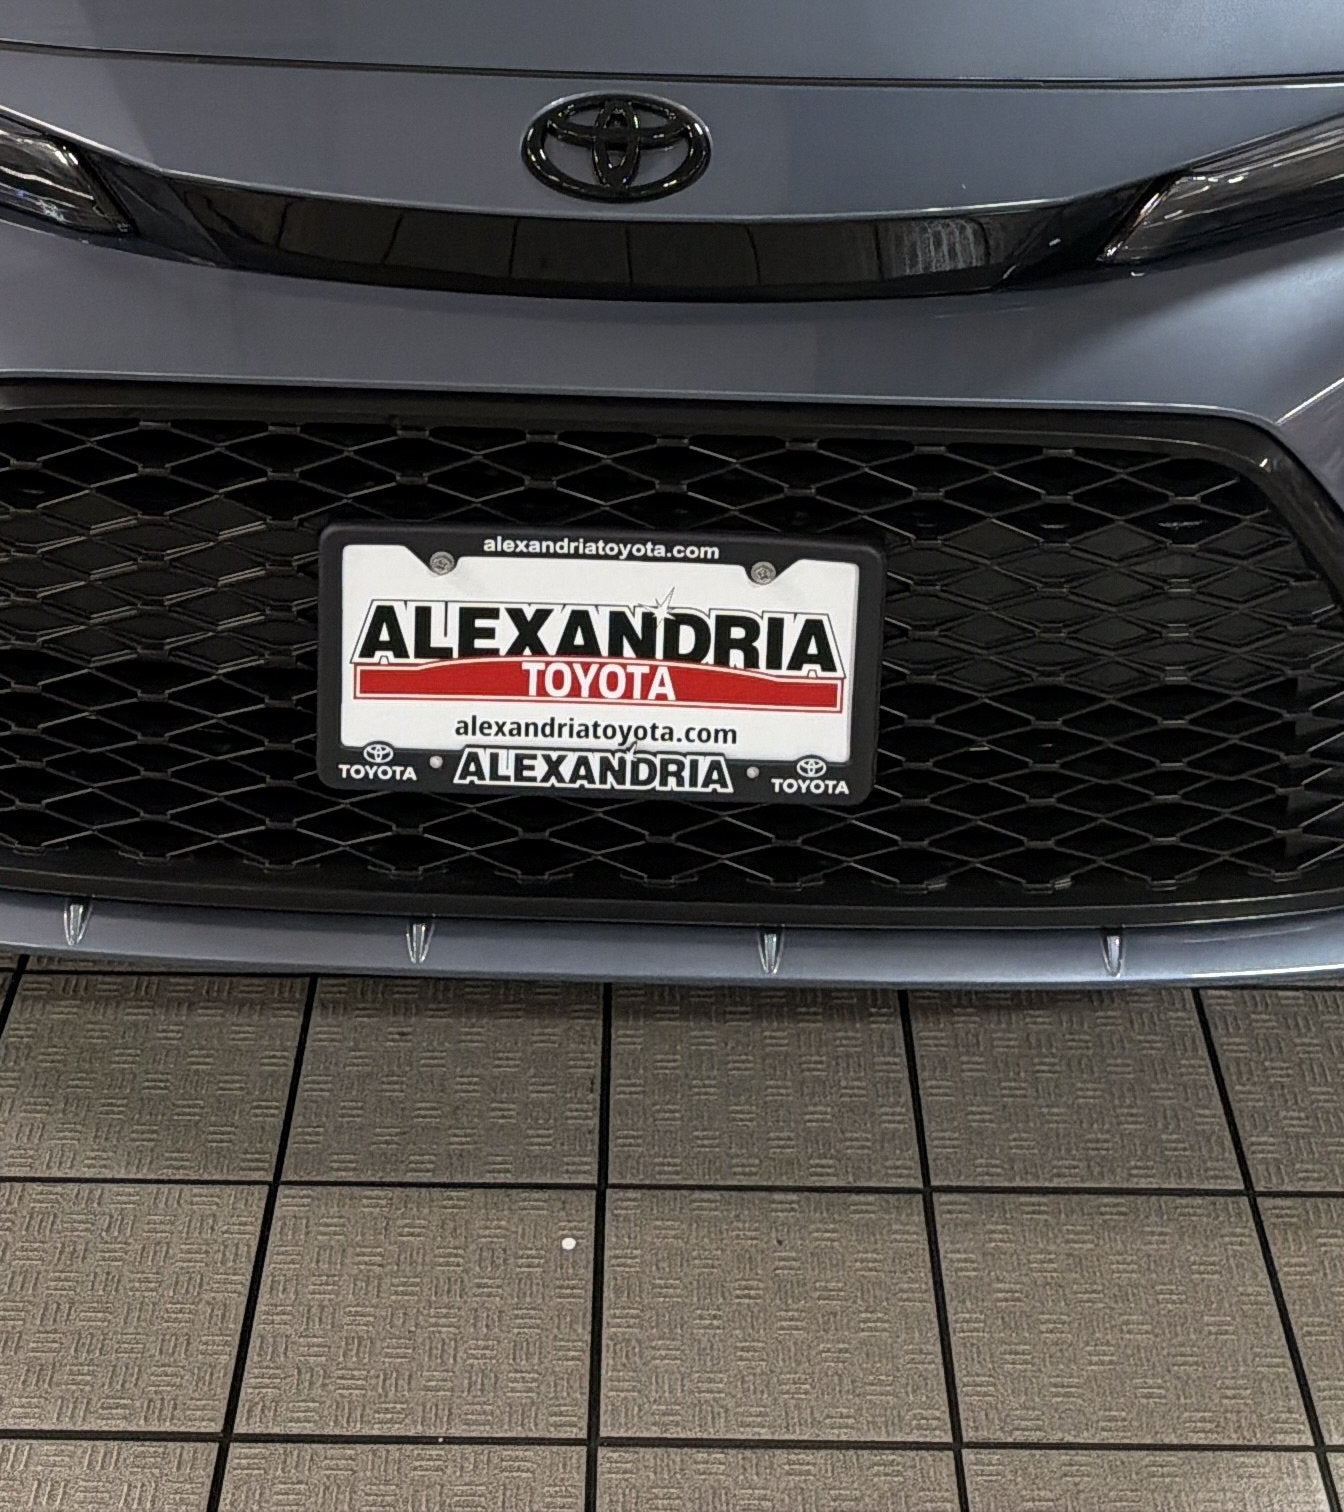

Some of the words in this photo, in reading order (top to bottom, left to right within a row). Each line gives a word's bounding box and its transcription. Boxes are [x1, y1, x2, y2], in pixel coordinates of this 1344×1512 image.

[483, 536, 720, 560] alexandriatoyota.com
[353, 600, 844, 677] ALEXANDRIA
[522, 661, 677, 701] TOYOTA
[454, 714, 738, 747] alexandriatoyota.com
[338, 763, 418, 781] TOYOTA
[453, 747, 734, 793] ALEXANDRIA
[770, 778, 850, 795] TOYOTA
